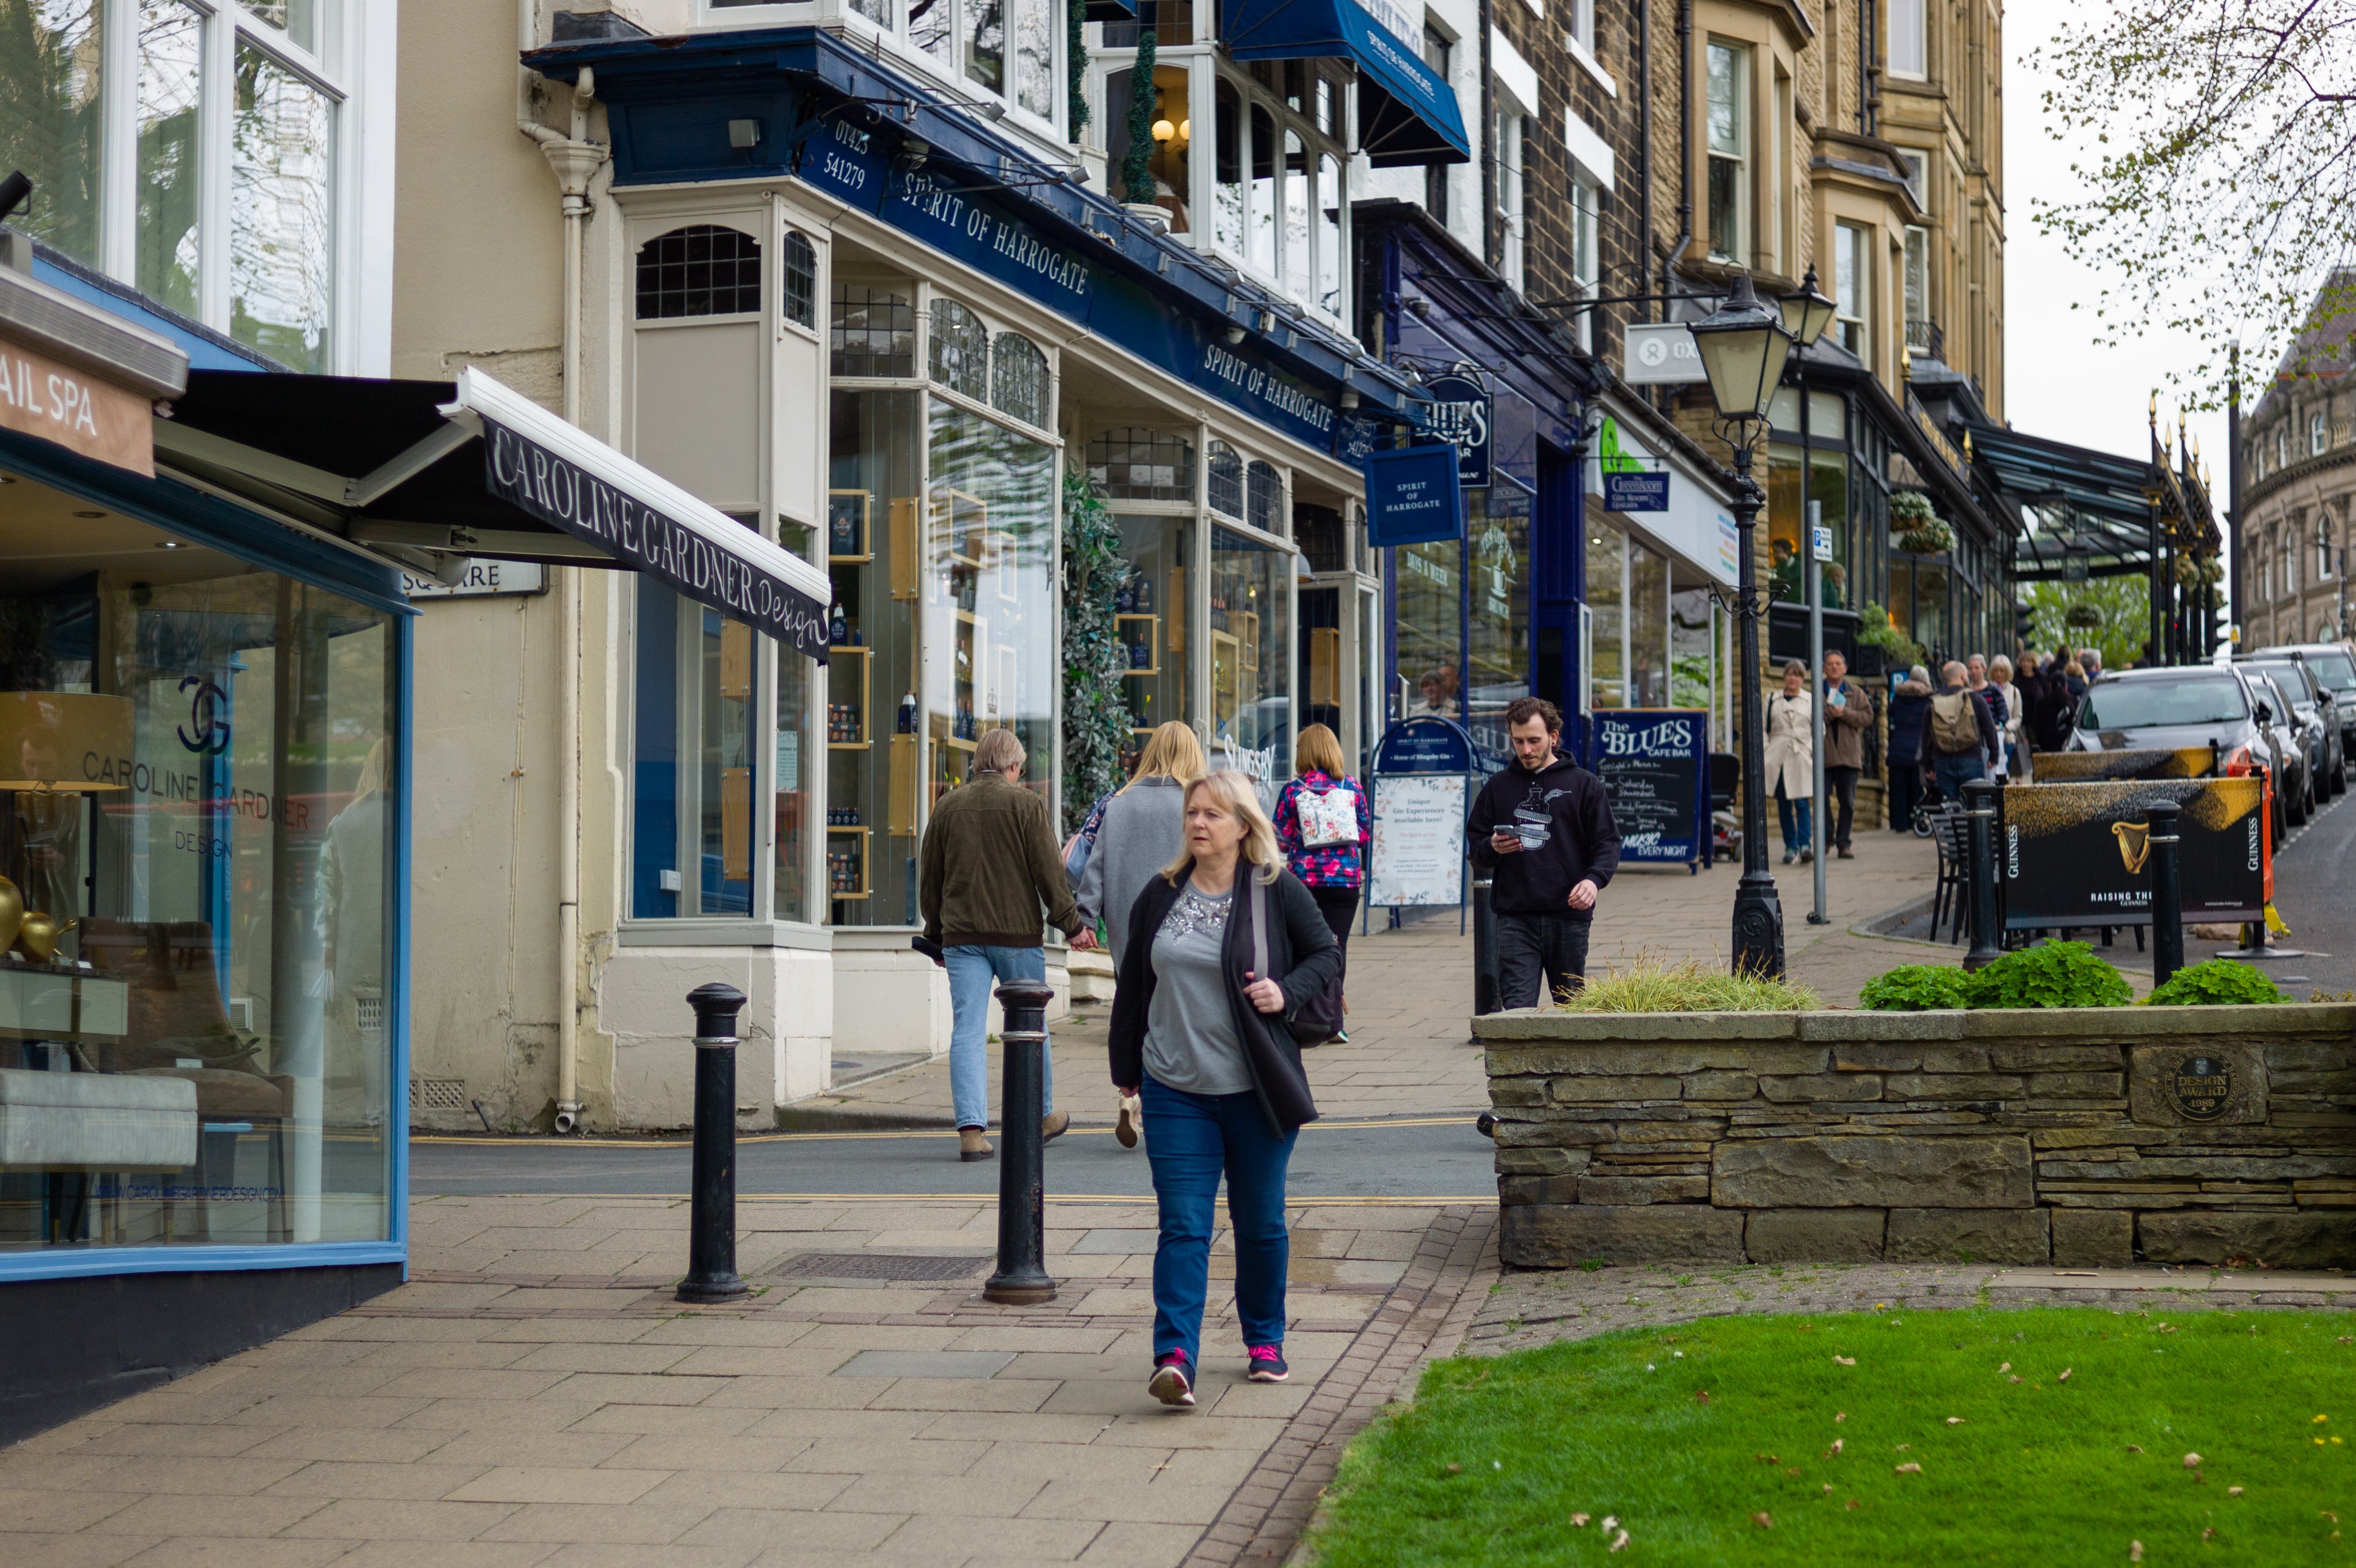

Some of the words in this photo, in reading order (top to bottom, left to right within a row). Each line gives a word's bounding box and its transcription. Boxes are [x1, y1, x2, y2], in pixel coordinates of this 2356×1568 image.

[836, 120, 868, 154] 01423
[824, 152, 865, 189] 541279
[902, 172, 963, 227] SPIRIT
[967, 208, 991, 241] OF
[993, 222, 1089, 295] HARROGATE
[0, 354, 42, 414] AIL
[48, 374, 97, 436] SPA
[1204, 344, 1248, 386] SPIRIT
[1248, 368, 1266, 395] OF
[1265, 377, 1333, 432] HARROGATE
[1397, 482, 1426, 491] SPIRIT
[1386, 500, 1440, 511] HARROGATE
[494, 427, 638, 553] CAROLINE
[643, 510, 756, 616] GARDNER
[759, 579, 828, 648] Design
[403, 565, 500, 590] SRE
[1407, 550, 1422, 573] DAYS
[1424, 560, 1428, 576] A
[1430, 563, 1448, 586] WEEK
[1488, 595, 1510, 620] BRUNCH
[1601, 719, 1692, 756] BLUES
[1603, 720, 1629, 732] The
[1224, 733, 1276, 789] SLINGSBY
[83, 750, 199, 805] CAROLINE
[213, 781, 309, 831] GARDNER
[1618, 776, 1655, 791] Saturday
[175, 831, 232, 859] DESIGN
[1623, 832, 1661, 849] MUSIC
[1638, 846, 1663, 856] EVERY
[1664, 845, 1688, 856] NIGHT
[2008, 824, 2018, 879] GUINNESS
[2248, 816, 2257, 872] GUINNESS
[2091, 891, 2131, 902] RAISING
[2186, 1050, 2220, 1059] BOROUGH
[2177, 1075, 2227, 1086] DESIGN
[2179, 1086, 2227, 1097] AWARD
